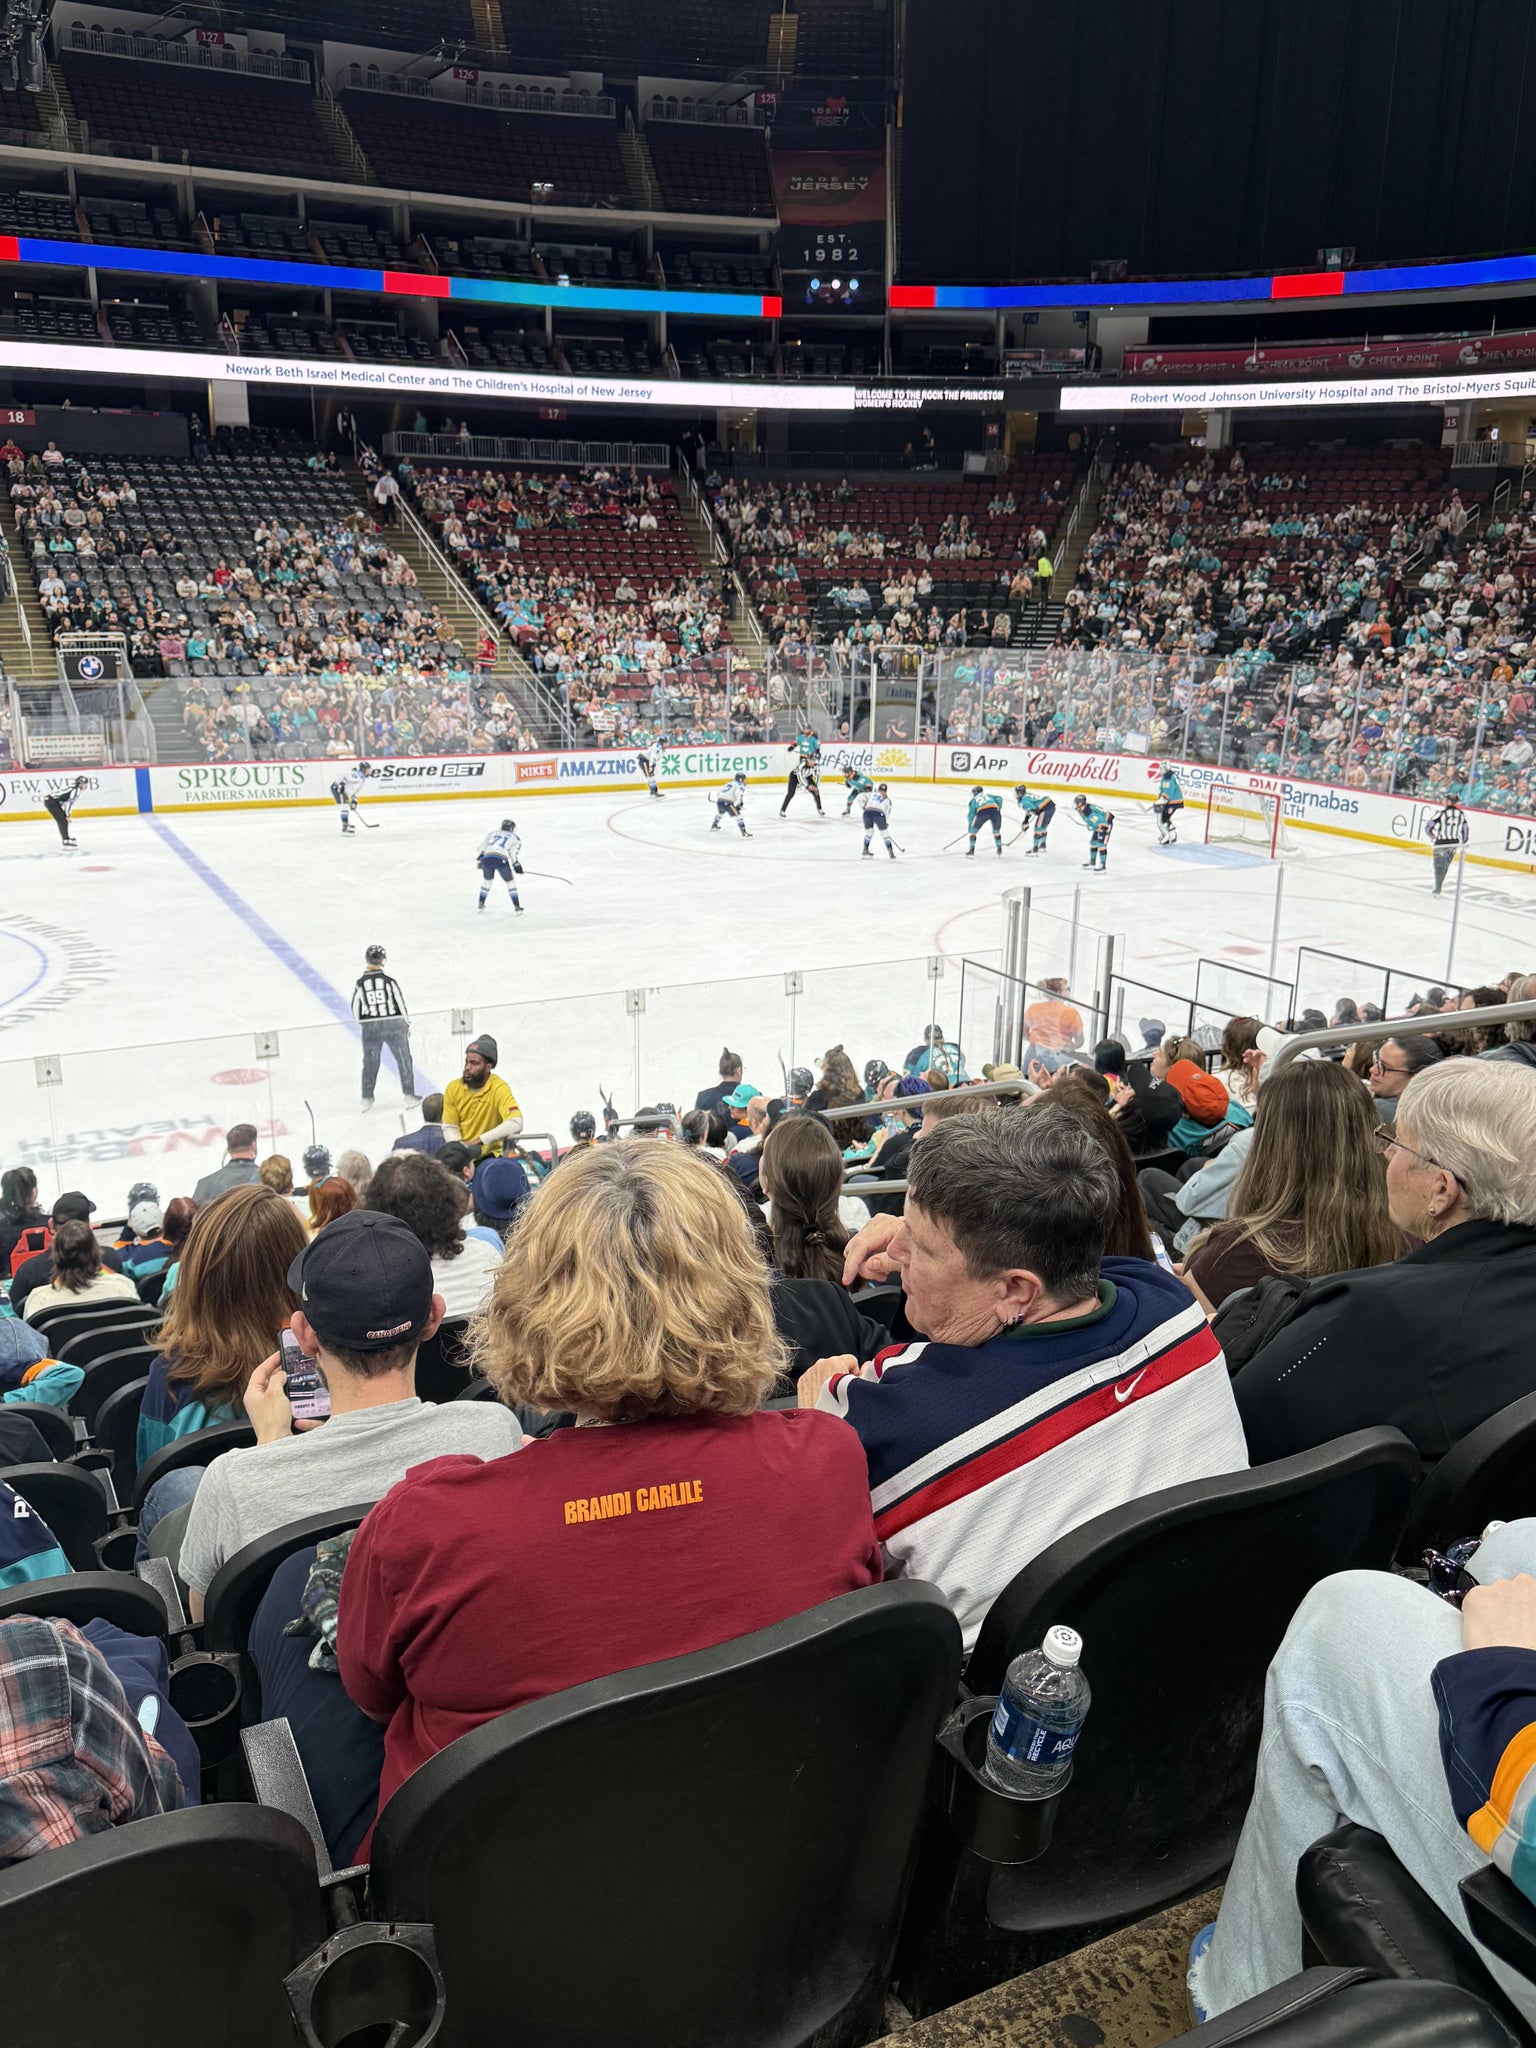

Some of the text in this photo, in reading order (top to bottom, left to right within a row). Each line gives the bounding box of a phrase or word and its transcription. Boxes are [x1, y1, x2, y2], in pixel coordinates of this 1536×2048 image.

[202, 31, 219, 43] 127
[459, 69, 474, 80] 126
[761, 94, 776, 104] 125
[790, 182, 869, 191] JERSEY
[817, 234, 851, 244] EST.
[803, 249, 859, 261] 1982
[1369, 353, 1440, 366] CHECK POINT
[226, 363, 653, 400] Newark Beth Israel Medical Center and The Children's Hospital of New Jersey
[855, 389, 1004, 401] WELCOME TO THE ROCK THE PRINCETON
[1130, 393, 1168, 403] Robert
[1173, 391, 1206, 402] Wood
[1209, 391, 1257, 402] Johnson
[1259, 388, 1316, 400] University
[1319, 386, 1368, 400] Hospital
[1370, 385, 1393, 397] and
[1397, 385, 1419, 396] The
[1423, 381, 1501, 395] Bristol-Myers
[855, 400, 923, 408] WOMEN'S HOCKEY
[7, 410, 25, 423] 18
[548, 409, 560, 420] 17
[1446, 418, 1457, 428] 15
[684, 753, 769, 774] Citizens
[819, 749, 873, 769] urfside
[370, 764, 482, 779] eScore BET
[520, 765, 553, 778] MIKE'S
[559, 759, 637, 777] AMAZING
[1027, 752, 1121, 782] Campbell's
[178, 764, 305, 789] SPROUTS
[186, 787, 300, 802] FARMERS MARKET
[488, 834, 509, 849] 71
[366, 989, 387, 1005] 89
[366, 1320, 412, 1339] CANADIENS
[563, 1479, 704, 1525] BRANDI CARLILE
[1031, 1729, 1048, 1762] RECYCLE
